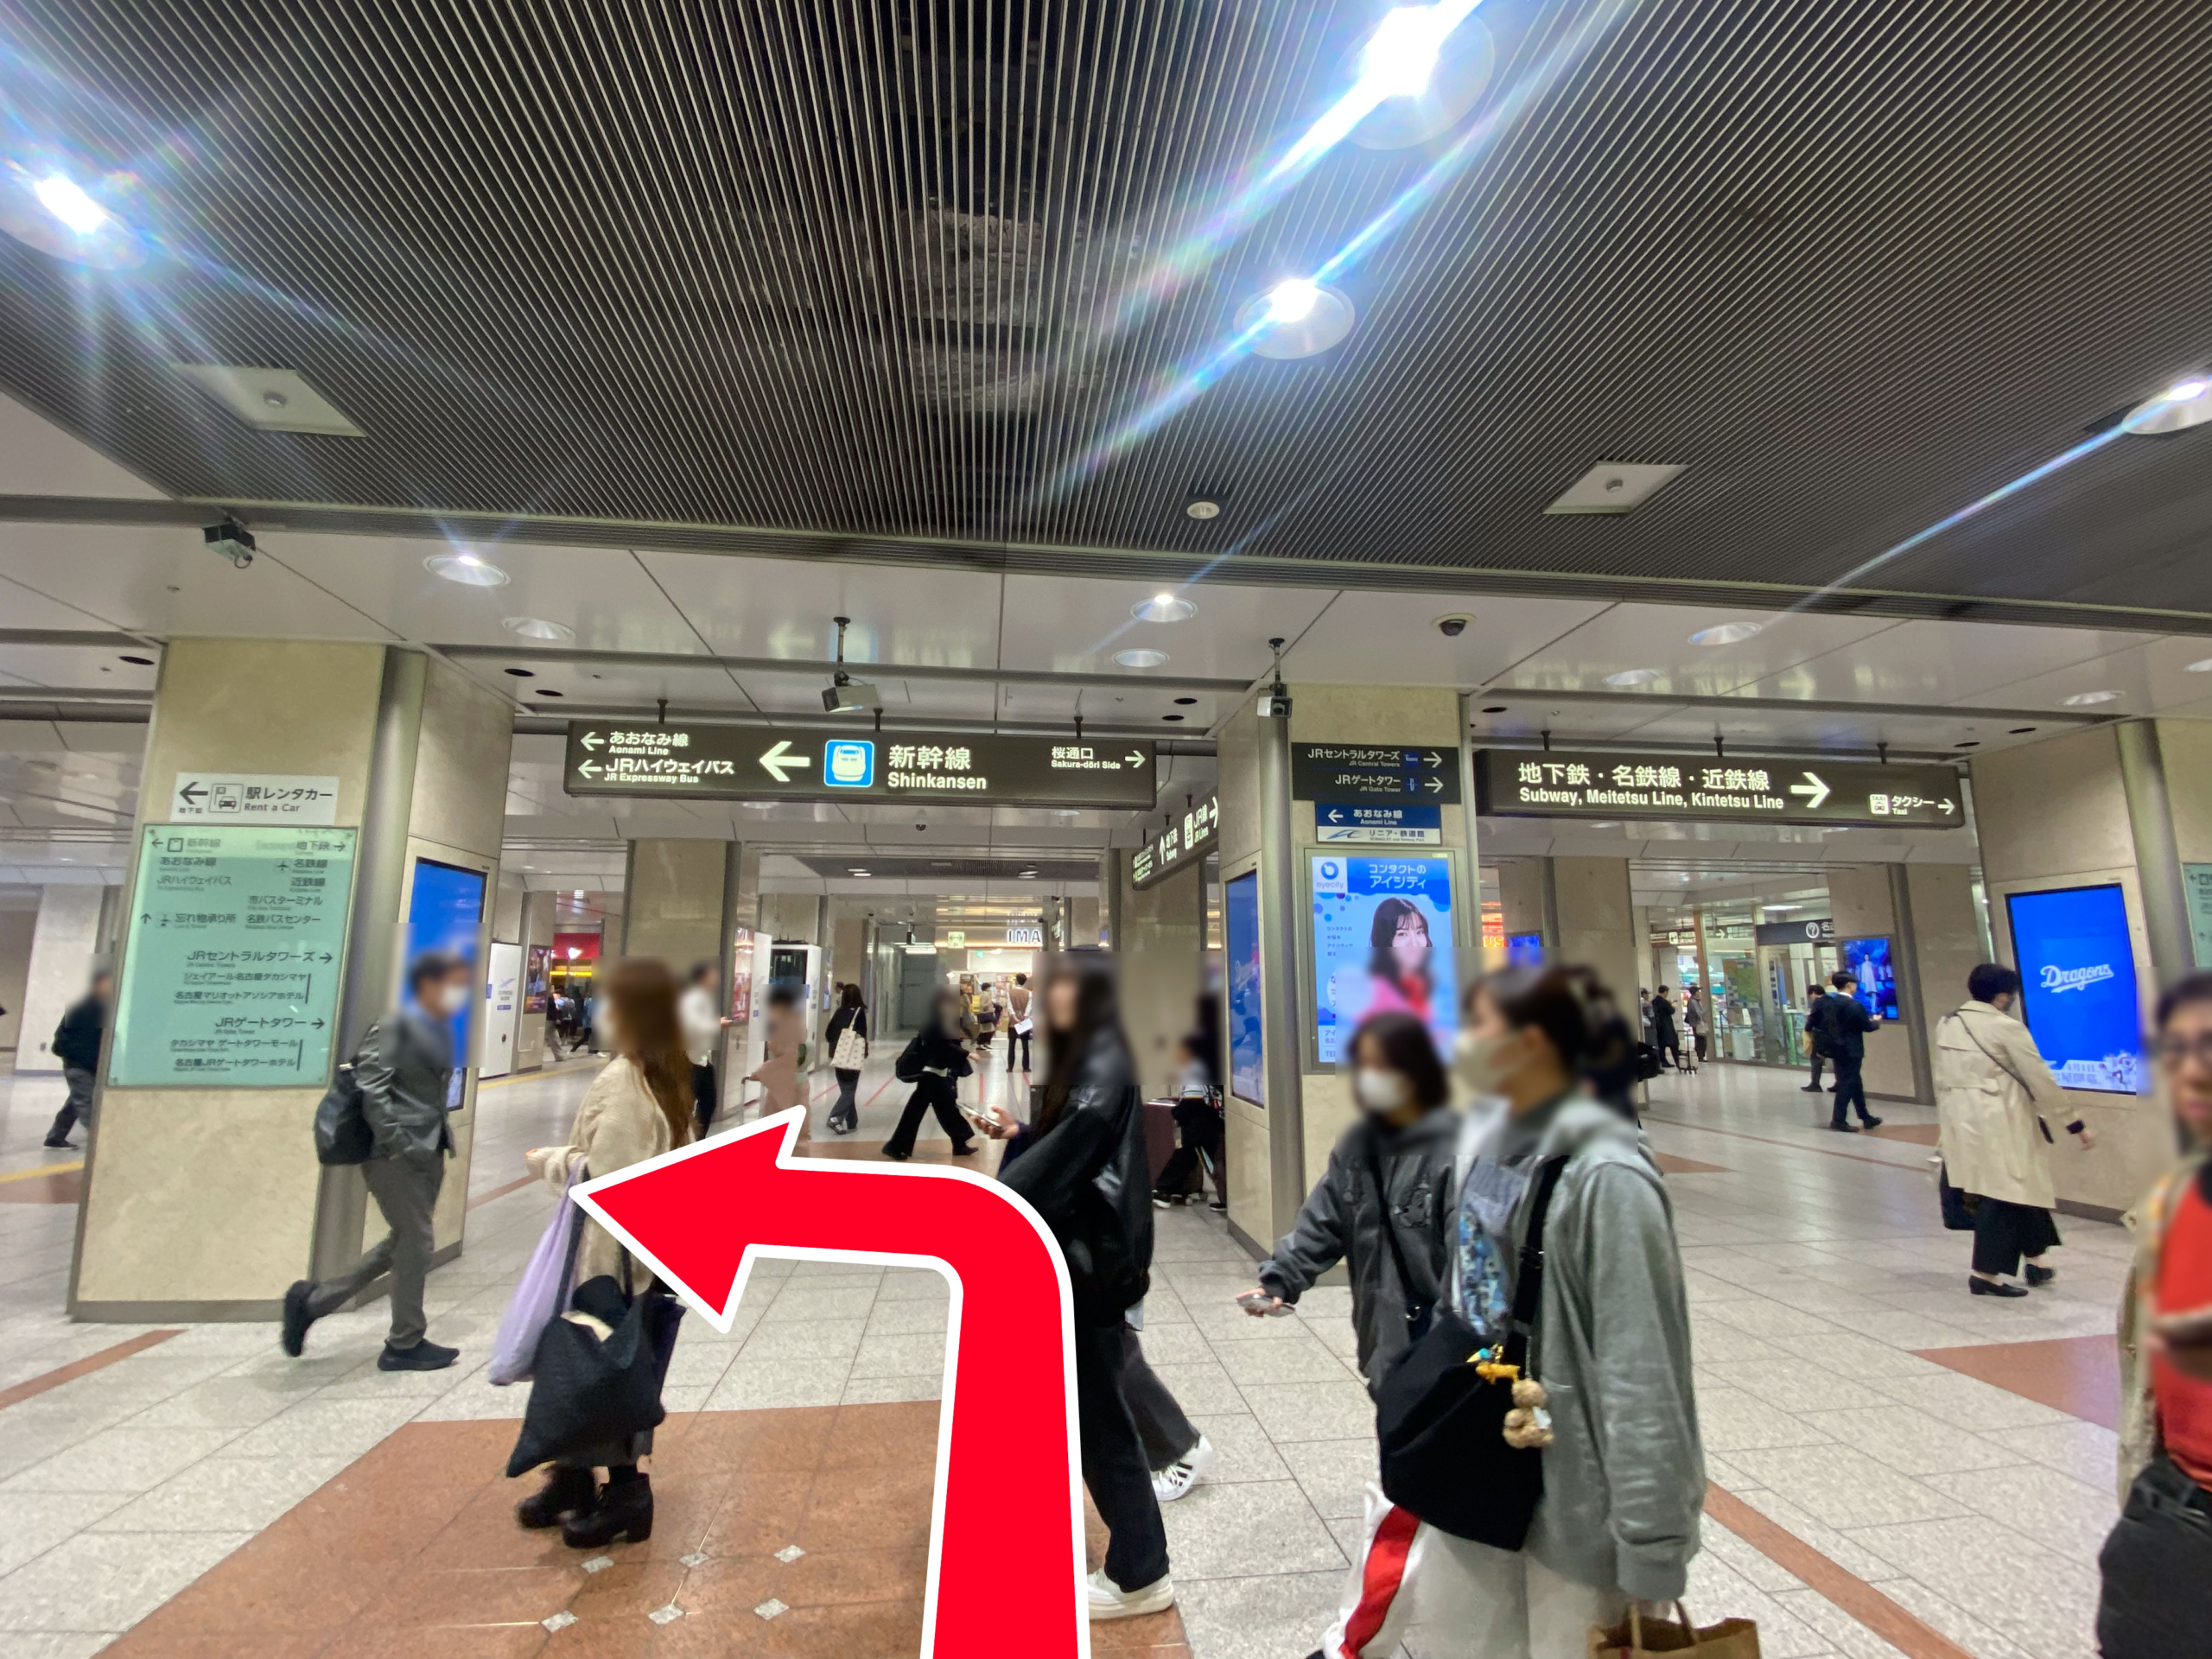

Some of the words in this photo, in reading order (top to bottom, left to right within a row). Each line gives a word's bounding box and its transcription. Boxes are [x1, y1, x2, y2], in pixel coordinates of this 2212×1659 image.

[609, 731, 689, 747] あおなみ線
[608, 746, 645, 754] Aonami
[648, 747, 669, 755] Line
[1051, 746, 1094, 760] 桜通口
[1307, 748, 1400, 760] JRセントラルタワーズ
[889, 745, 971, 770] 新幹線
[605, 758, 734, 774] JRハイウェイバス
[1102, 760, 1121, 769] Side
[604, 772, 617, 781] JR
[620, 773, 677, 784] Expressway
[680, 774, 699, 783] Bus
[887, 772, 987, 790] Shinkansen
[1335, 774, 1401, 785] JRゲートタワー
[1518, 762, 1770, 791] 地下鉄・名鉄線・近鉄線
[246, 786, 334, 801] 駅レンタカー
[1519, 788, 1582, 806] Subway,
[1586, 789, 1649, 804] Meitetsu
[1652, 791, 1688, 808] Line,
[1691, 792, 1749, 808] Kintetsu
[1753, 793, 1784, 809] Line
[1891, 795, 1935, 807] タクシー
[244, 803, 268, 812] Rent
[282, 804, 301, 813] Car
[1353, 809, 1403, 819] あおなみ線
[1370, 864, 1427, 874] コンタクトの
[157, 875, 232, 886] JRハイウェイバス
[1316, 881, 1344, 890] eyecity
[1370, 875, 1427, 889] アイシティ
[188, 950, 315, 962] JRセントラルタワーズ
[2040, 963, 2113, 991] Dragons
[215, 1017, 307, 1028] JRゲートタワー
